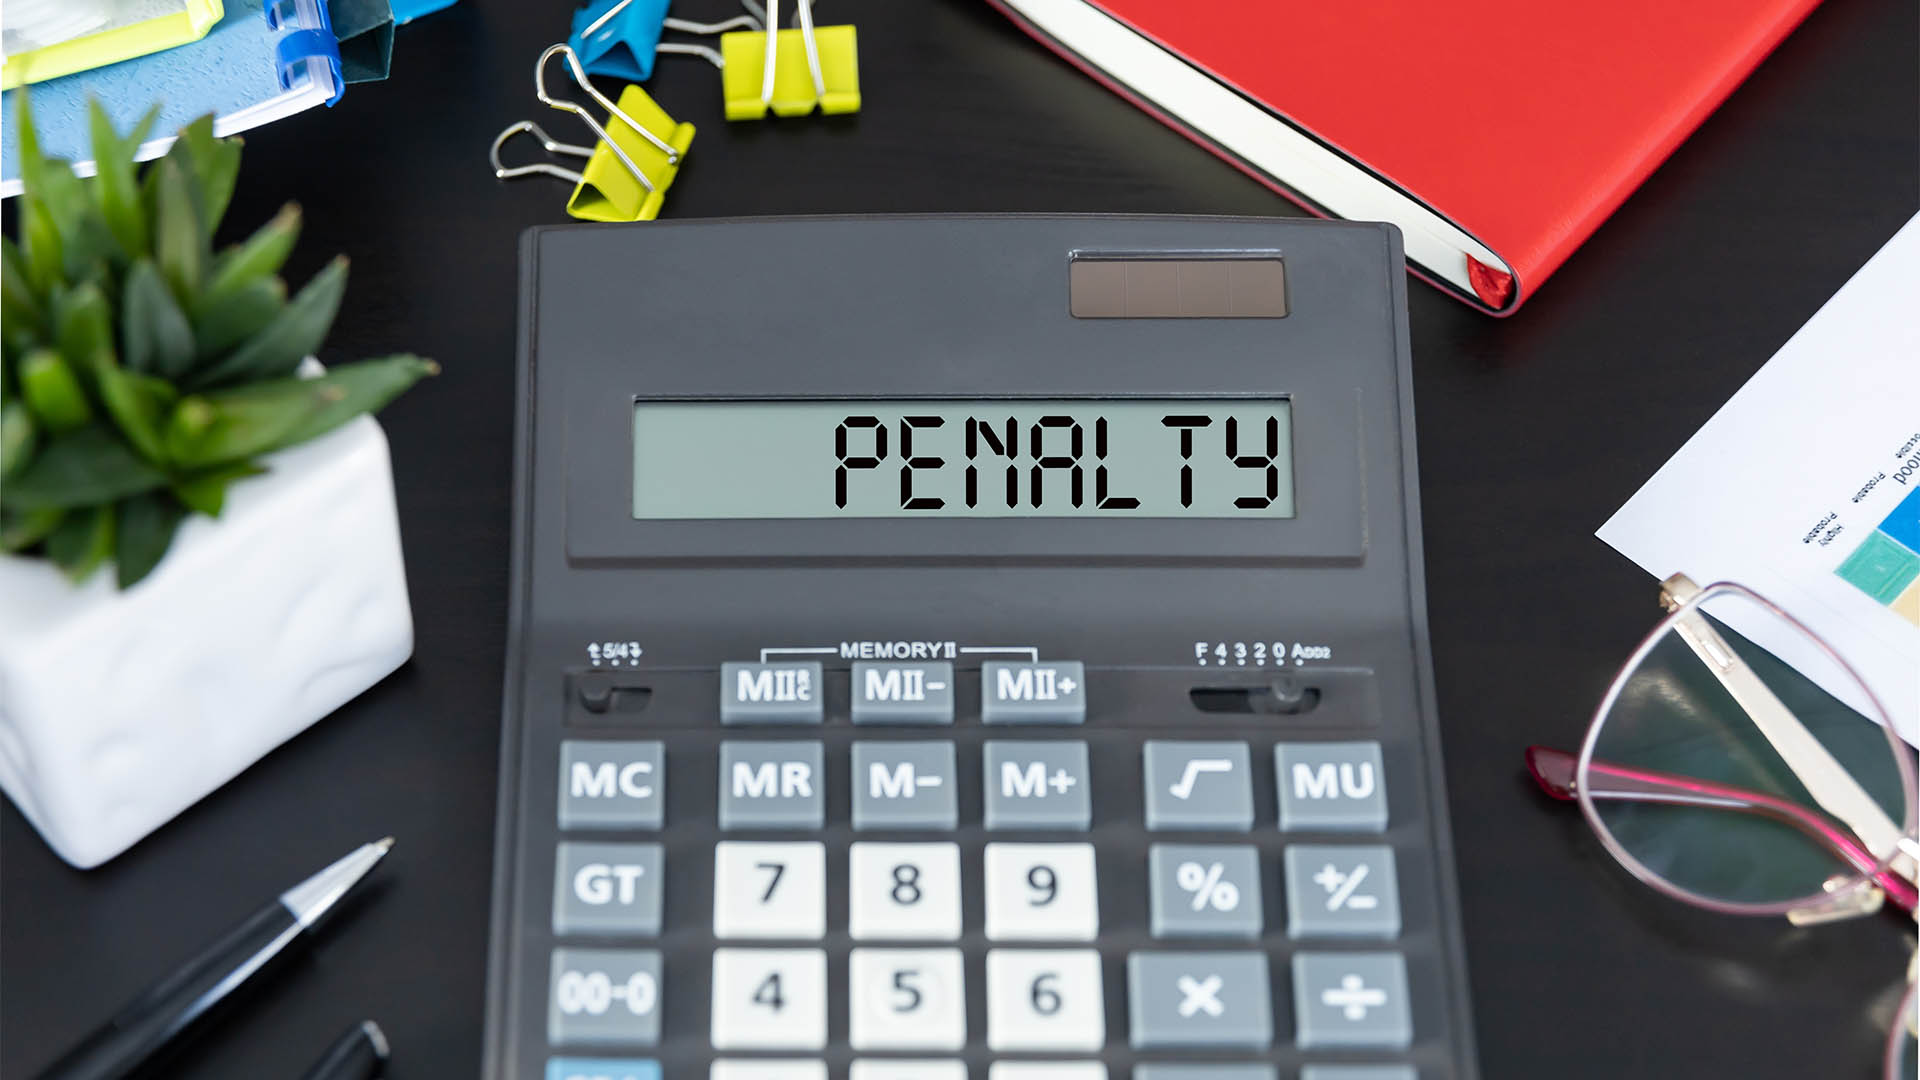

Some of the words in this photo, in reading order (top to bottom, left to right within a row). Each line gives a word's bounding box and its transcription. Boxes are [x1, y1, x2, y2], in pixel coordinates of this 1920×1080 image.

[835, 415, 1279, 510] PENALTY
[1851, 472, 1886, 503] Probable
[1802, 511, 1838, 544] Probable
[1195, 642, 1209, 659] F
[1214, 642, 1228, 659] 4
[1234, 642, 1248, 659] 3
[1253, 642, 1267, 659] 2
[570, 762, 652, 798] MC
[732, 762, 812, 798] MR
[870, 762, 942, 798] M-
[1001, 762, 1076, 798] M+
[1292, 762, 1375, 799] MU
[573, 863, 644, 905] GT
[757, 863, 787, 903] 7
[890, 863, 923, 906] 8
[1026, 865, 1059, 907] 9
[752, 972, 786, 1012] 4
[892, 969, 923, 1013] 5
[1029, 973, 1063, 1016] 6
